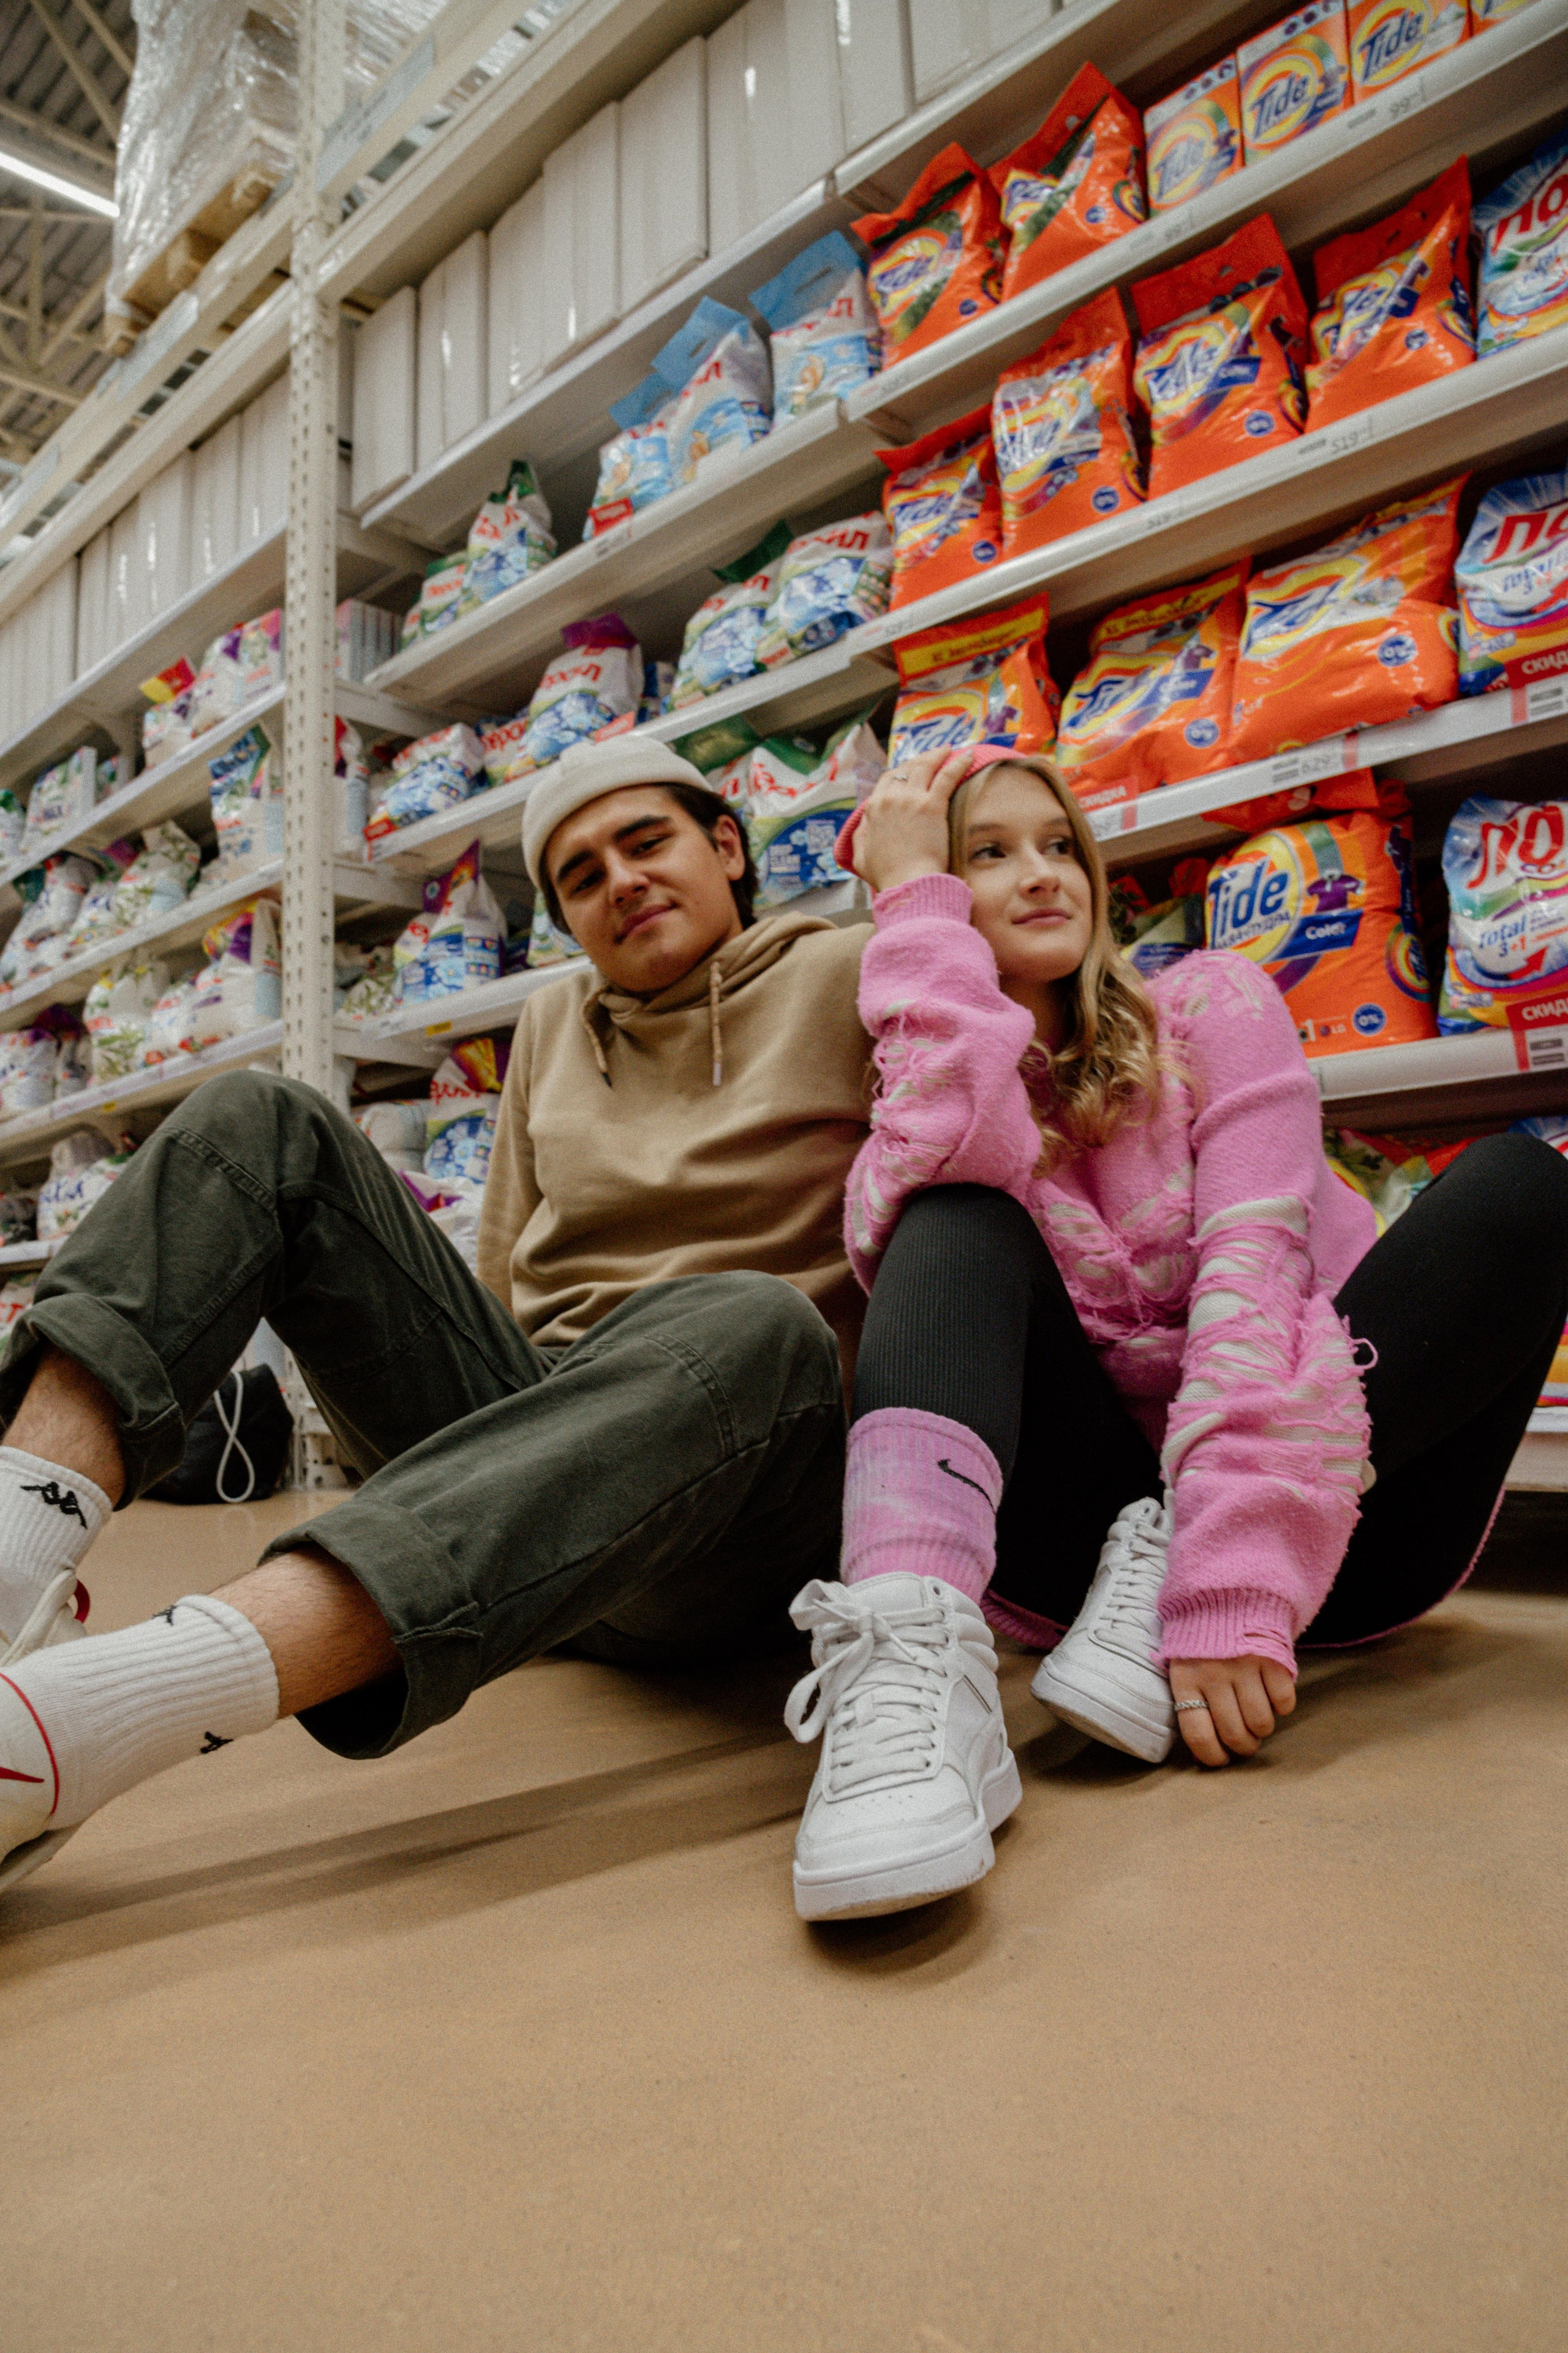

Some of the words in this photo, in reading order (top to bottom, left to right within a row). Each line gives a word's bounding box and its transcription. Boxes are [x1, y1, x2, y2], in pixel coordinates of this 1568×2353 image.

[1357, 7, 1424, 85] Tide
[1250, 72, 1310, 140] Tide
[1208, 859, 1290, 949] Tide
[1305, 921, 1347, 940] Color
